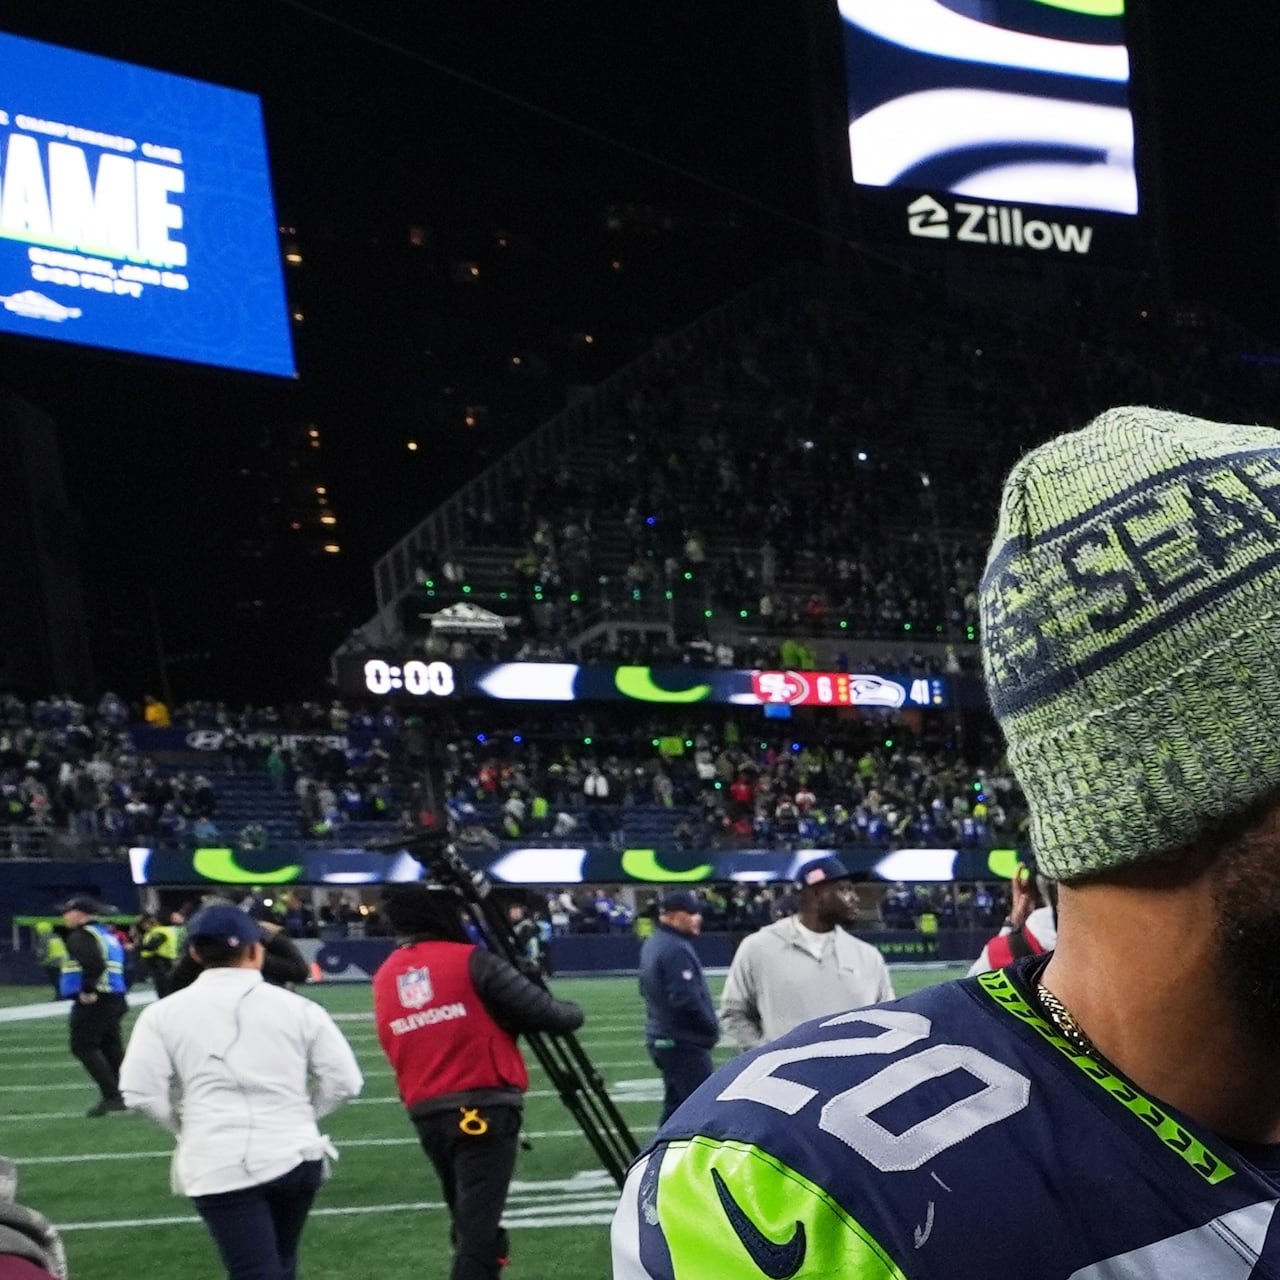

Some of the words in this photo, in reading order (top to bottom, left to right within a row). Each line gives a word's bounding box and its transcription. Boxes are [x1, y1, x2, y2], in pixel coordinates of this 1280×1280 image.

[0, 132, 188, 267] AME
[954, 203, 1093, 253] Zillow
[364, 659, 455, 696] 0:00
[817, 676, 833, 703] 6
[910, 679, 930, 704] 41
[389, 1002, 467, 1037] TELEVISION
[716, 1009, 1032, 1173] 20
